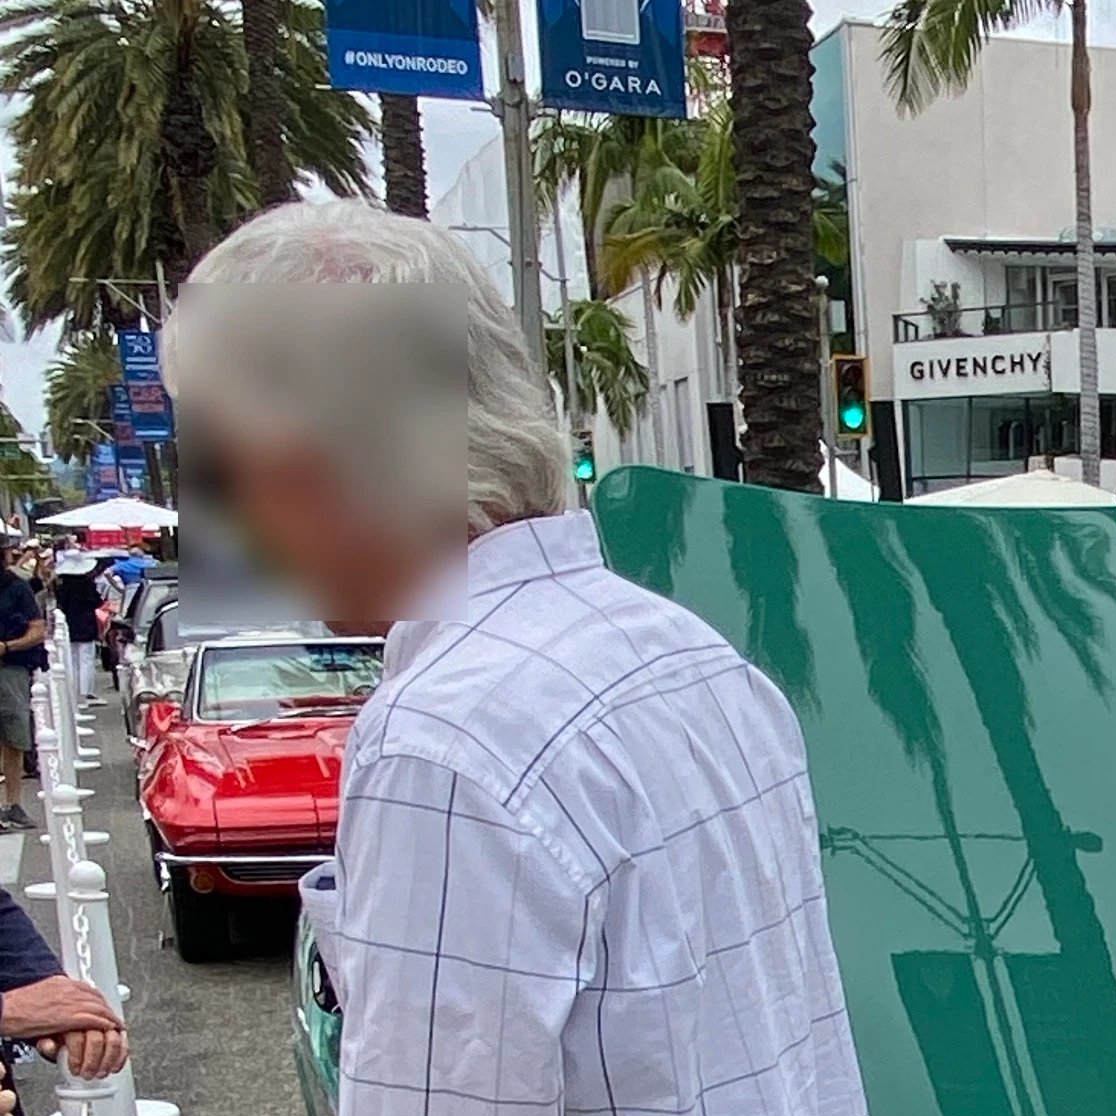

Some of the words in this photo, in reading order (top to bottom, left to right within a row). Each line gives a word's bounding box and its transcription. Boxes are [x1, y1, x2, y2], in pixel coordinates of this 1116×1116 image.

[344, 50, 468, 75] #ONLYONRODEO
[565, 70, 662, 96] O'GARA
[910, 352, 1042, 380] GIVENCHY
